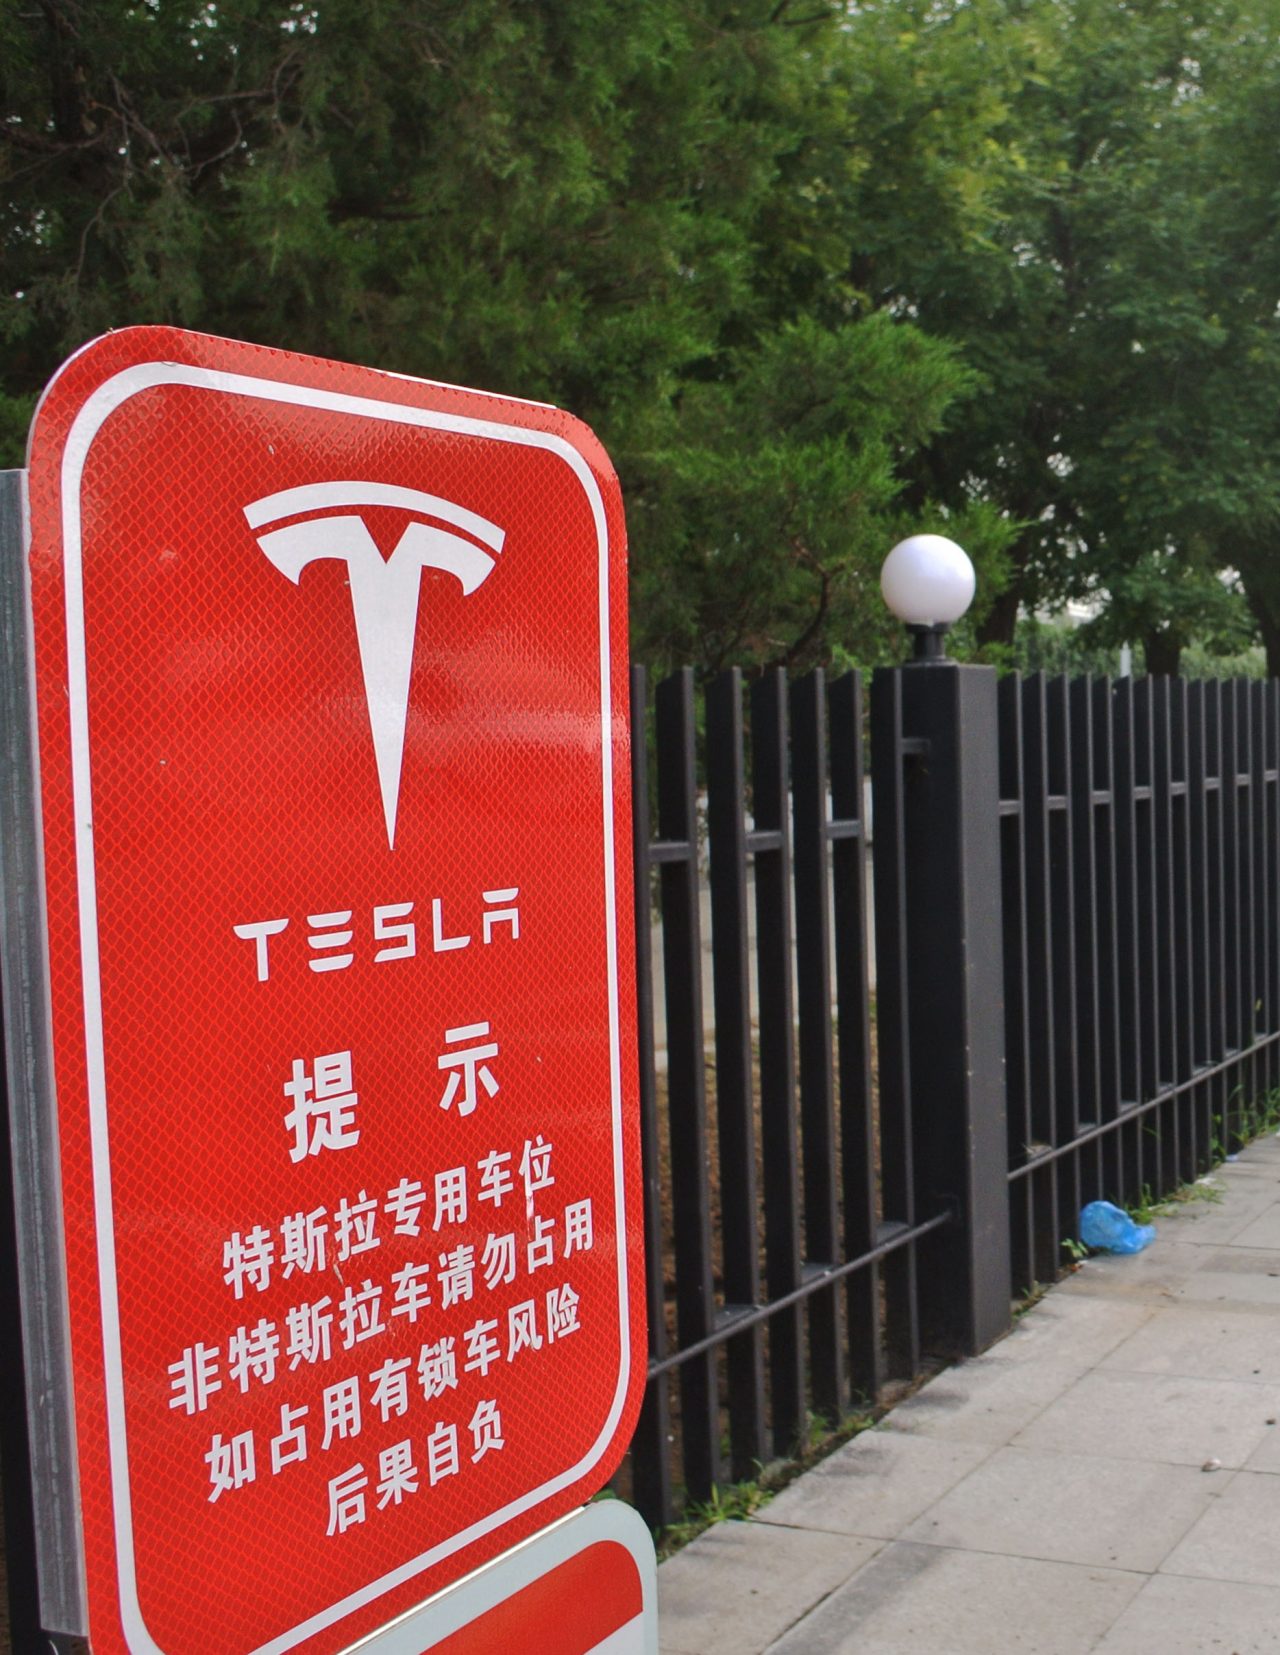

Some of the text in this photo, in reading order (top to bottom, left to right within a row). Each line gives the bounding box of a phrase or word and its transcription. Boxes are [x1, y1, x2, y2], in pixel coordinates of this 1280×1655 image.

[232, 886, 520, 982] TESLA
[223, 1134, 555, 1299] 特斯拉专用车位
[168, 1198, 593, 1414] 非特斯拉车请勿占用
[205, 1283, 581, 1503] 如占用有锁车风险
[326, 1400, 505, 1537] 后果自负
